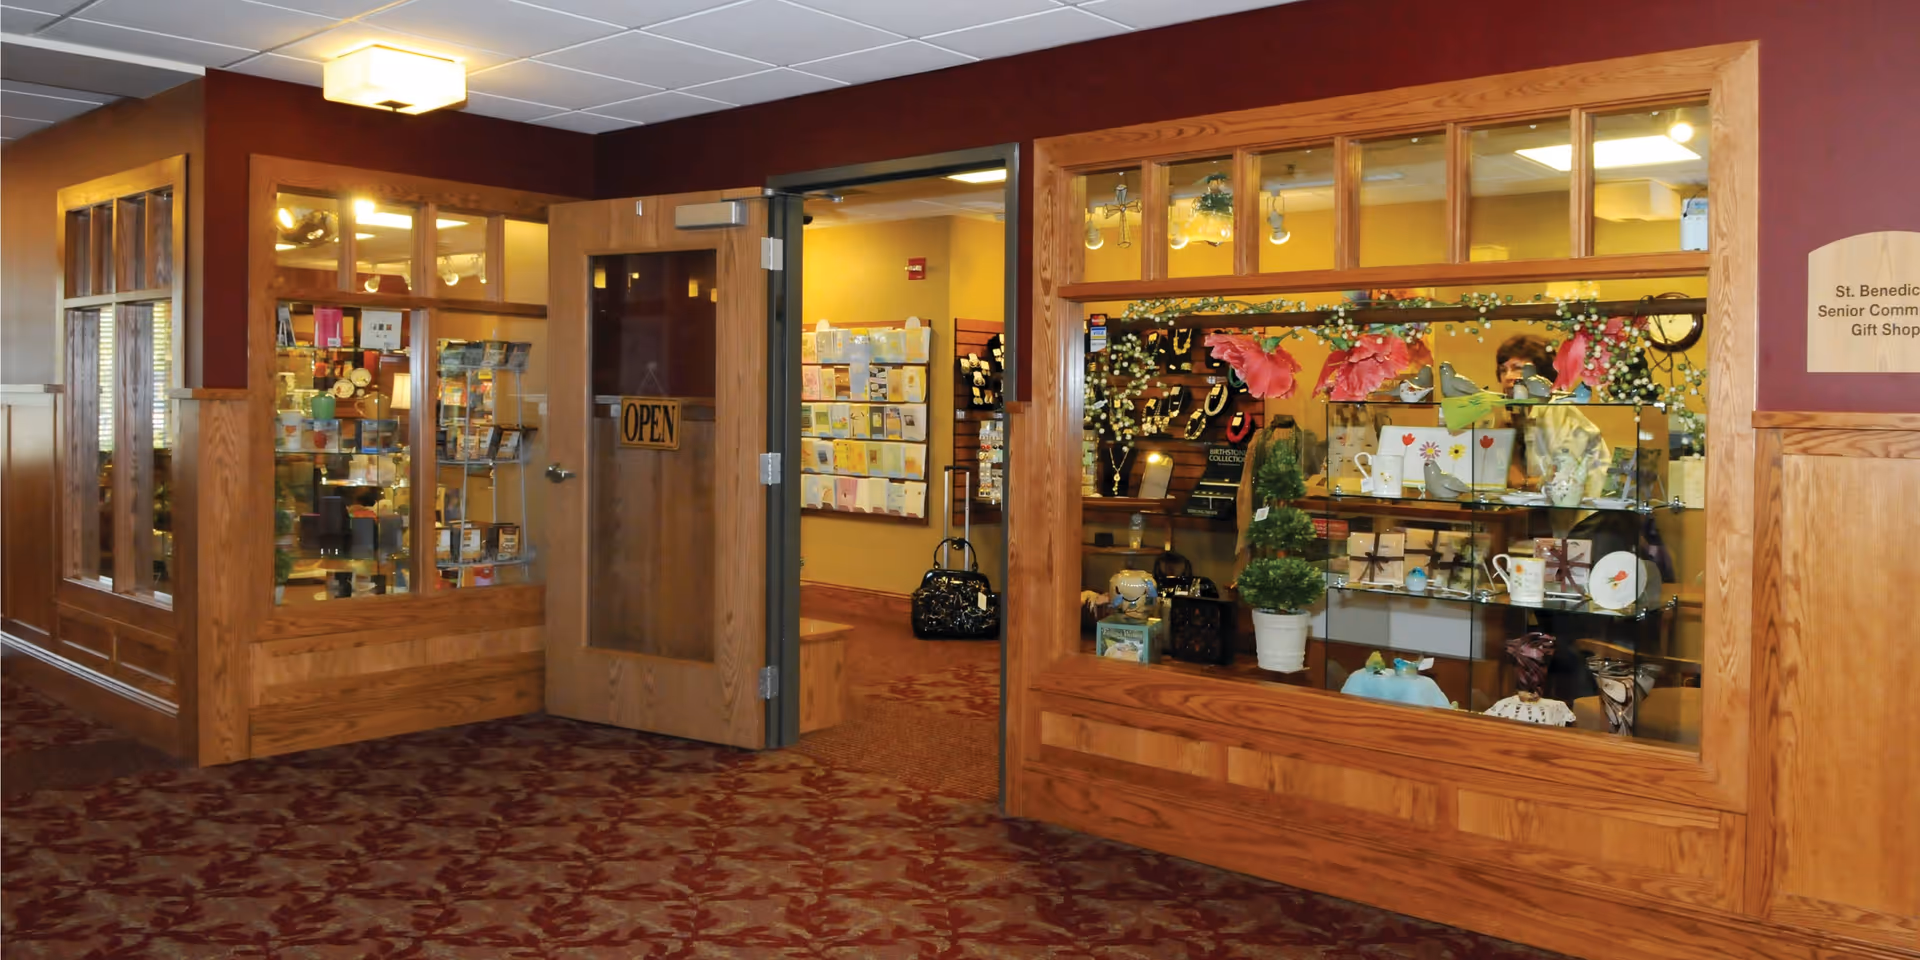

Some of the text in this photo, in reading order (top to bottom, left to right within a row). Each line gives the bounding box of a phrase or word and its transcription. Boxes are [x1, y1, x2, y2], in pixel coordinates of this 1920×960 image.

[1836, 285, 1855, 297] St.
[1818, 304, 1865, 317] Senior
[1851, 323, 1920, 338] Gift Shop
[624, 403, 676, 443] OPEN
[1209, 448, 1246, 456] BIRTHSTON
[1208, 455, 1244, 463] COLLECTIO
